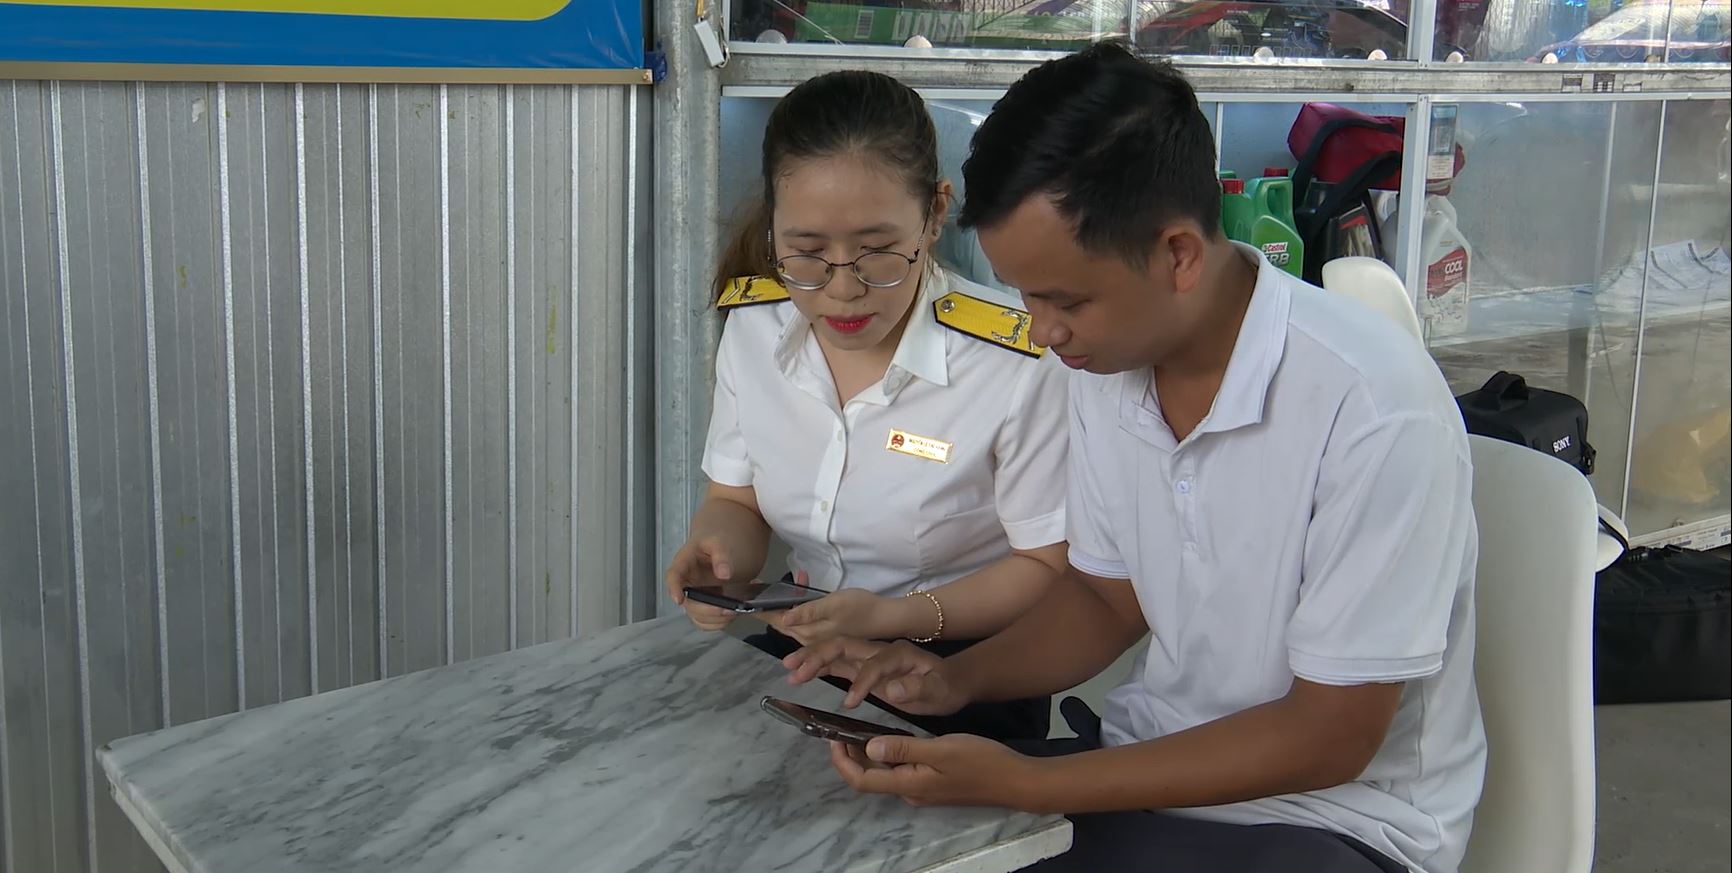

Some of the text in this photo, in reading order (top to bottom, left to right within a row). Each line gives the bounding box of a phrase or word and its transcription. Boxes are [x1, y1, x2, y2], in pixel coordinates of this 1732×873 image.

[1264, 253, 1290, 266] RB
[1444, 259, 1463, 274] COOL
[1552, 435, 1571, 453] SONY
